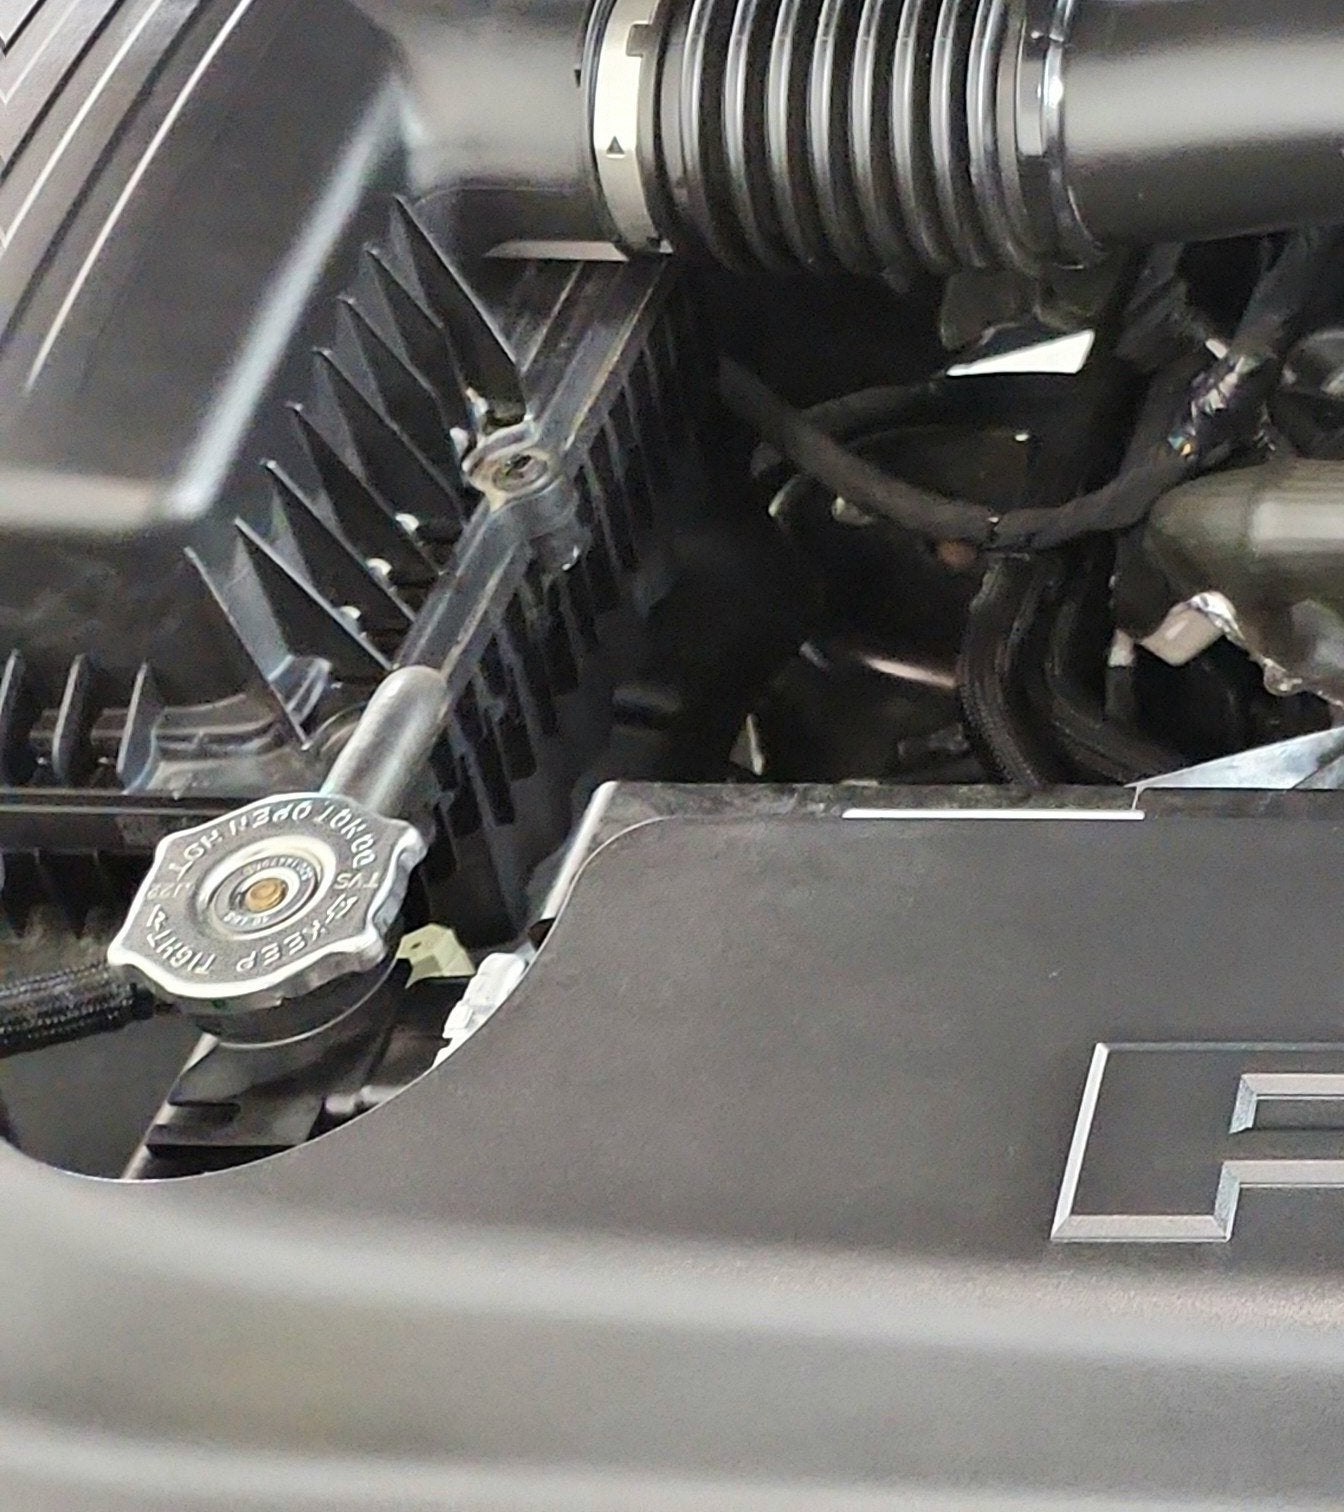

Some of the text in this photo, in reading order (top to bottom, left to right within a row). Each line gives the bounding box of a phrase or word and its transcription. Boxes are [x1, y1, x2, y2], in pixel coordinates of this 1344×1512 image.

[228, 800, 313, 836] OPEN
[168, 829, 223, 882] HOT
[333, 871, 380, 890] TVS
[146, 919, 327, 975] KEEP TIGHT
